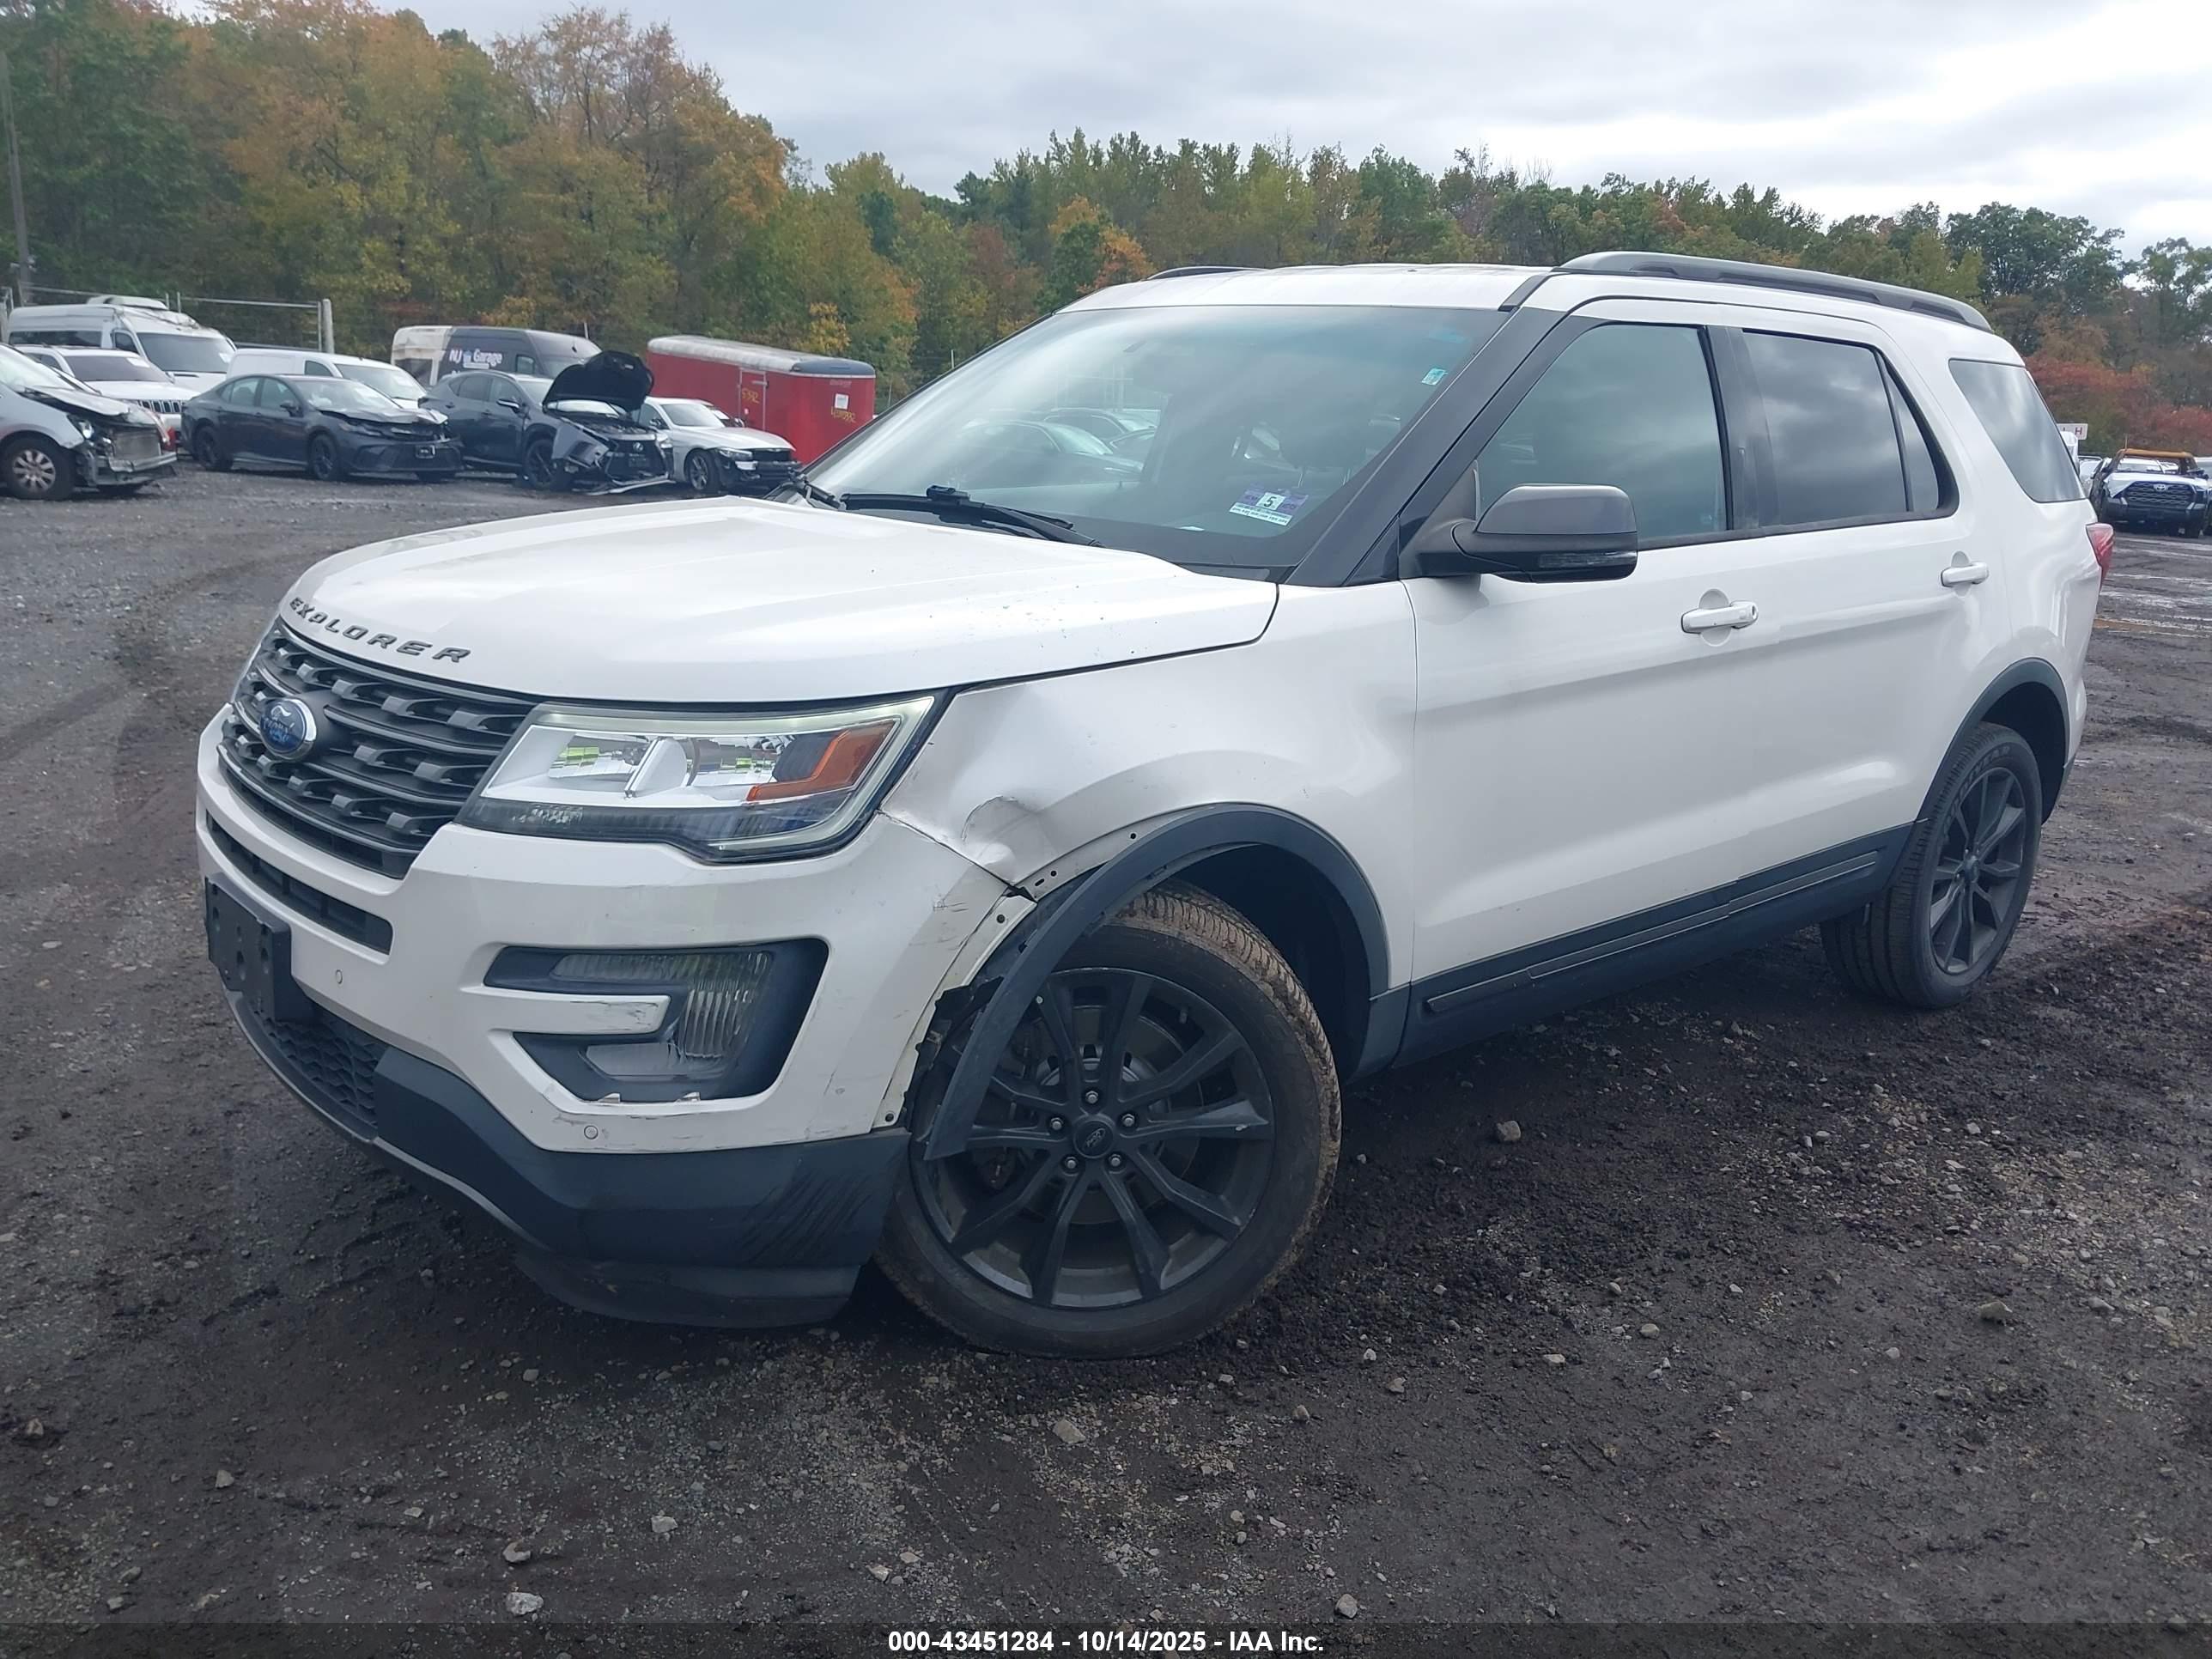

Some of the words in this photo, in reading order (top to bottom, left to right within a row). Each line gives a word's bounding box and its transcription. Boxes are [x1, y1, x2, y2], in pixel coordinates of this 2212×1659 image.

[449, 349, 463, 363] NJ
[473, 348, 502, 367] Garage
[1263, 496, 1277, 507] 5
[289, 597, 471, 663] EXPLORER
